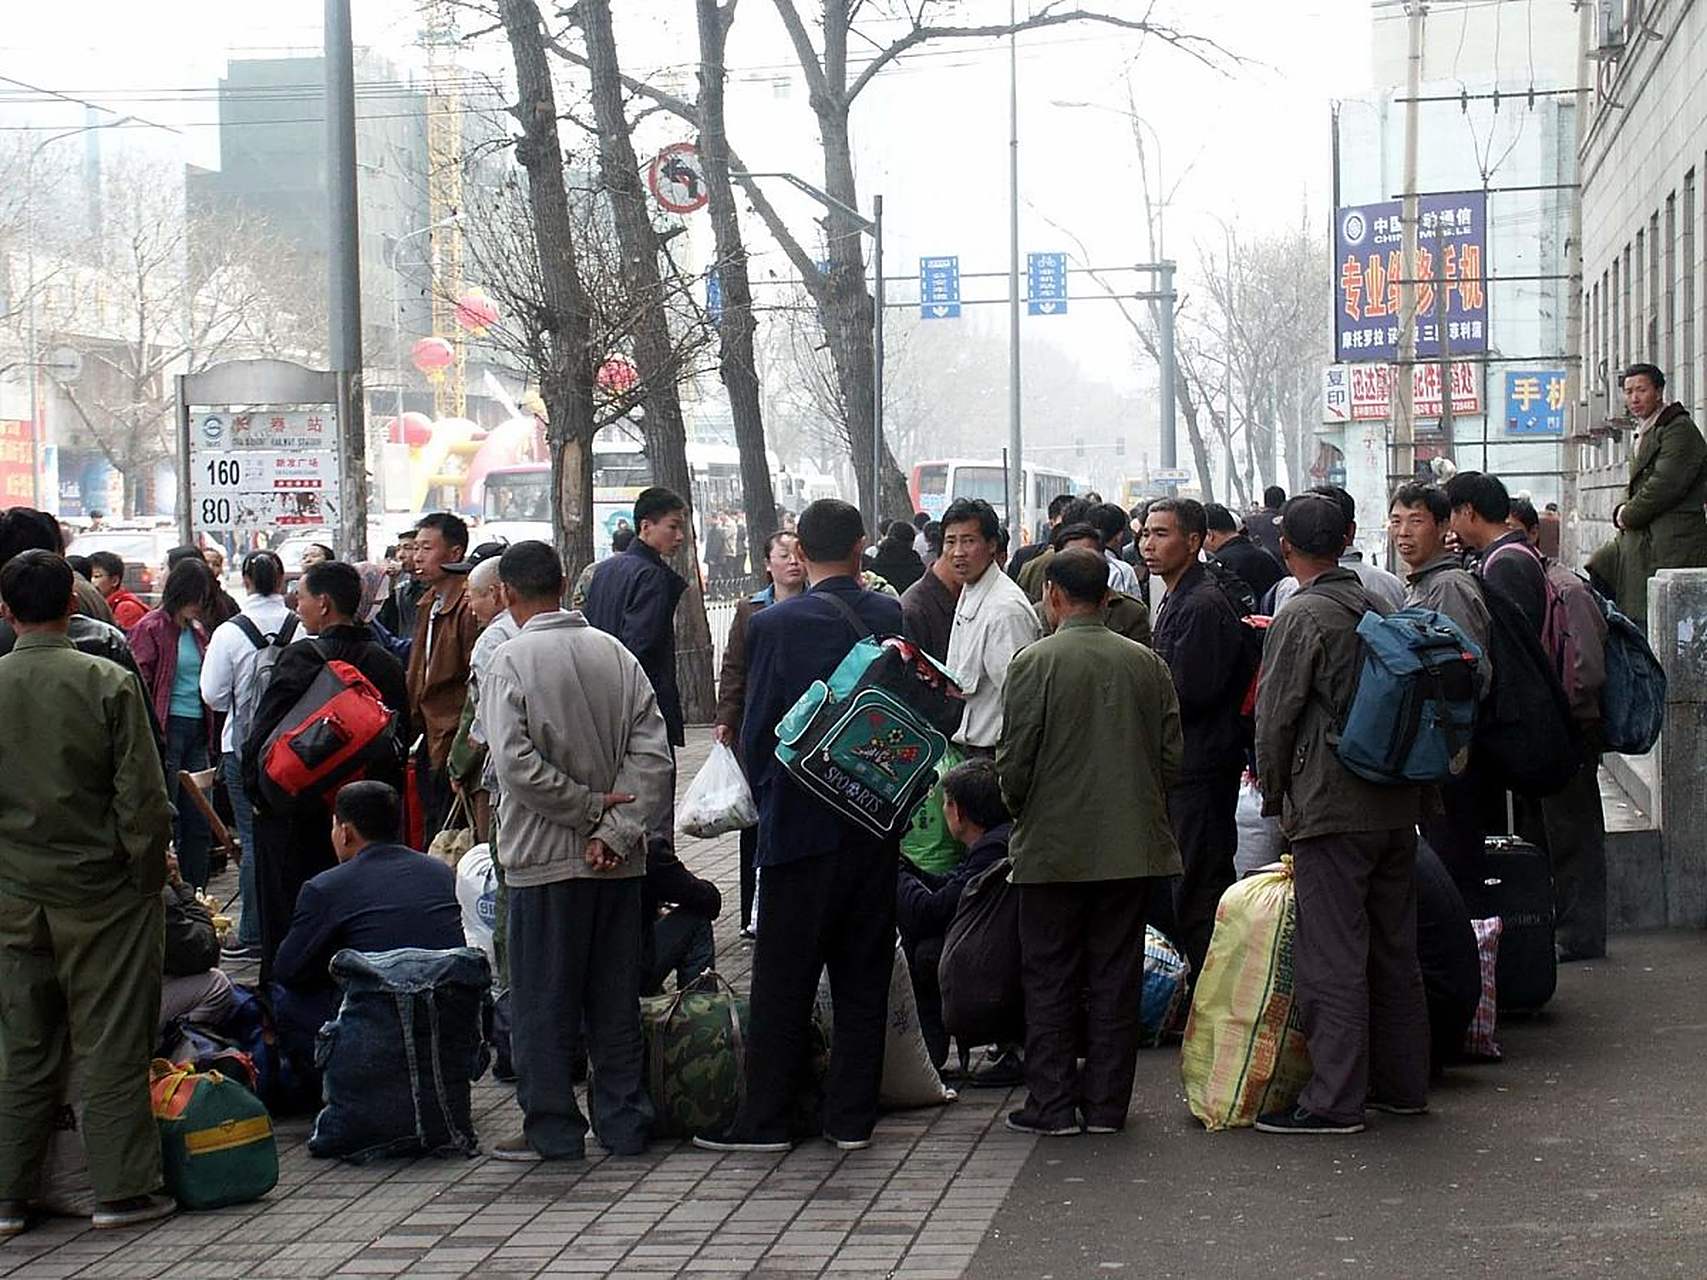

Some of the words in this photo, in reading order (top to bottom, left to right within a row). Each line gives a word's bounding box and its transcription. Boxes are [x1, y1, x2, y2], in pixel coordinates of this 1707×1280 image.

[1373, 207, 1473, 235] 中国动通信
[1327, 370, 1345, 406] 复印
[1511, 376, 1566, 411] 手机
[207, 460, 240, 485] 160
[202, 498, 230, 523] 80
[823, 766, 883, 813] SPORTS
